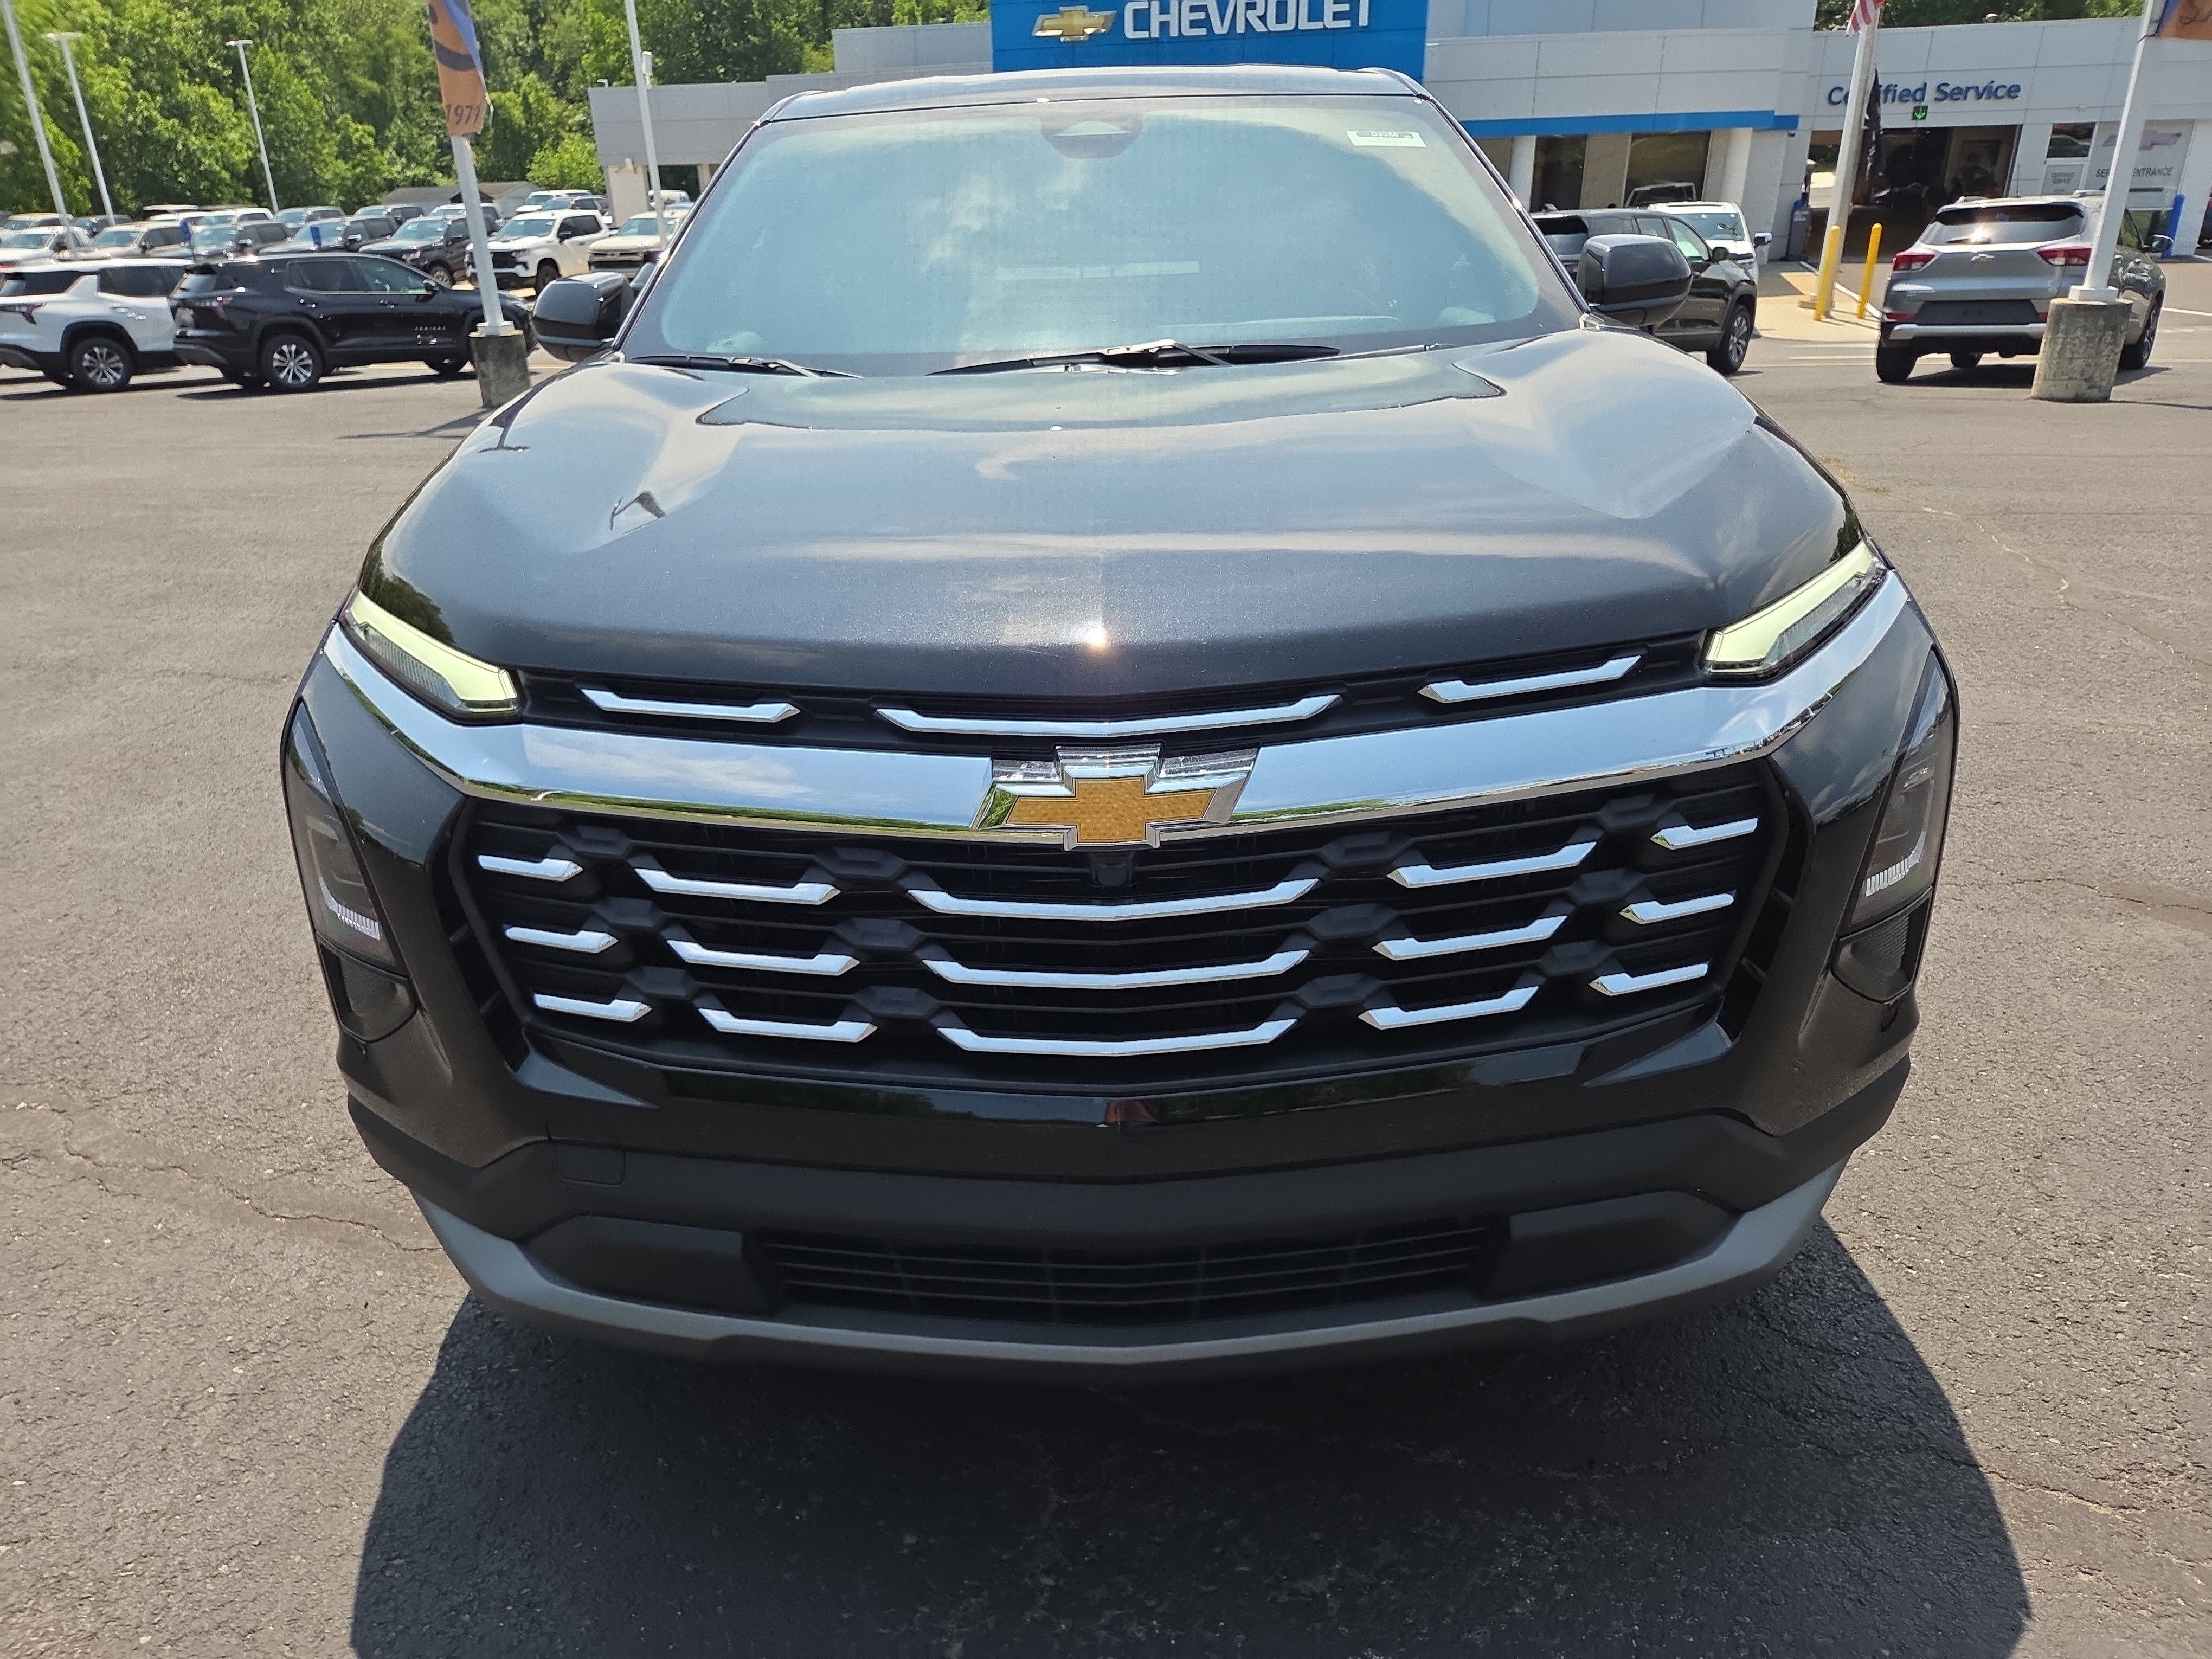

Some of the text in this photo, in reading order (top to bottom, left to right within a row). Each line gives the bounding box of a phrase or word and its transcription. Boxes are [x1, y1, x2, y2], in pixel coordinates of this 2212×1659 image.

[1124, 0, 1371, 39] CHEVROLET
[1827, 80, 2021, 105] Cfied Service
[2132, 166, 2174, 178] ENTRANCE
